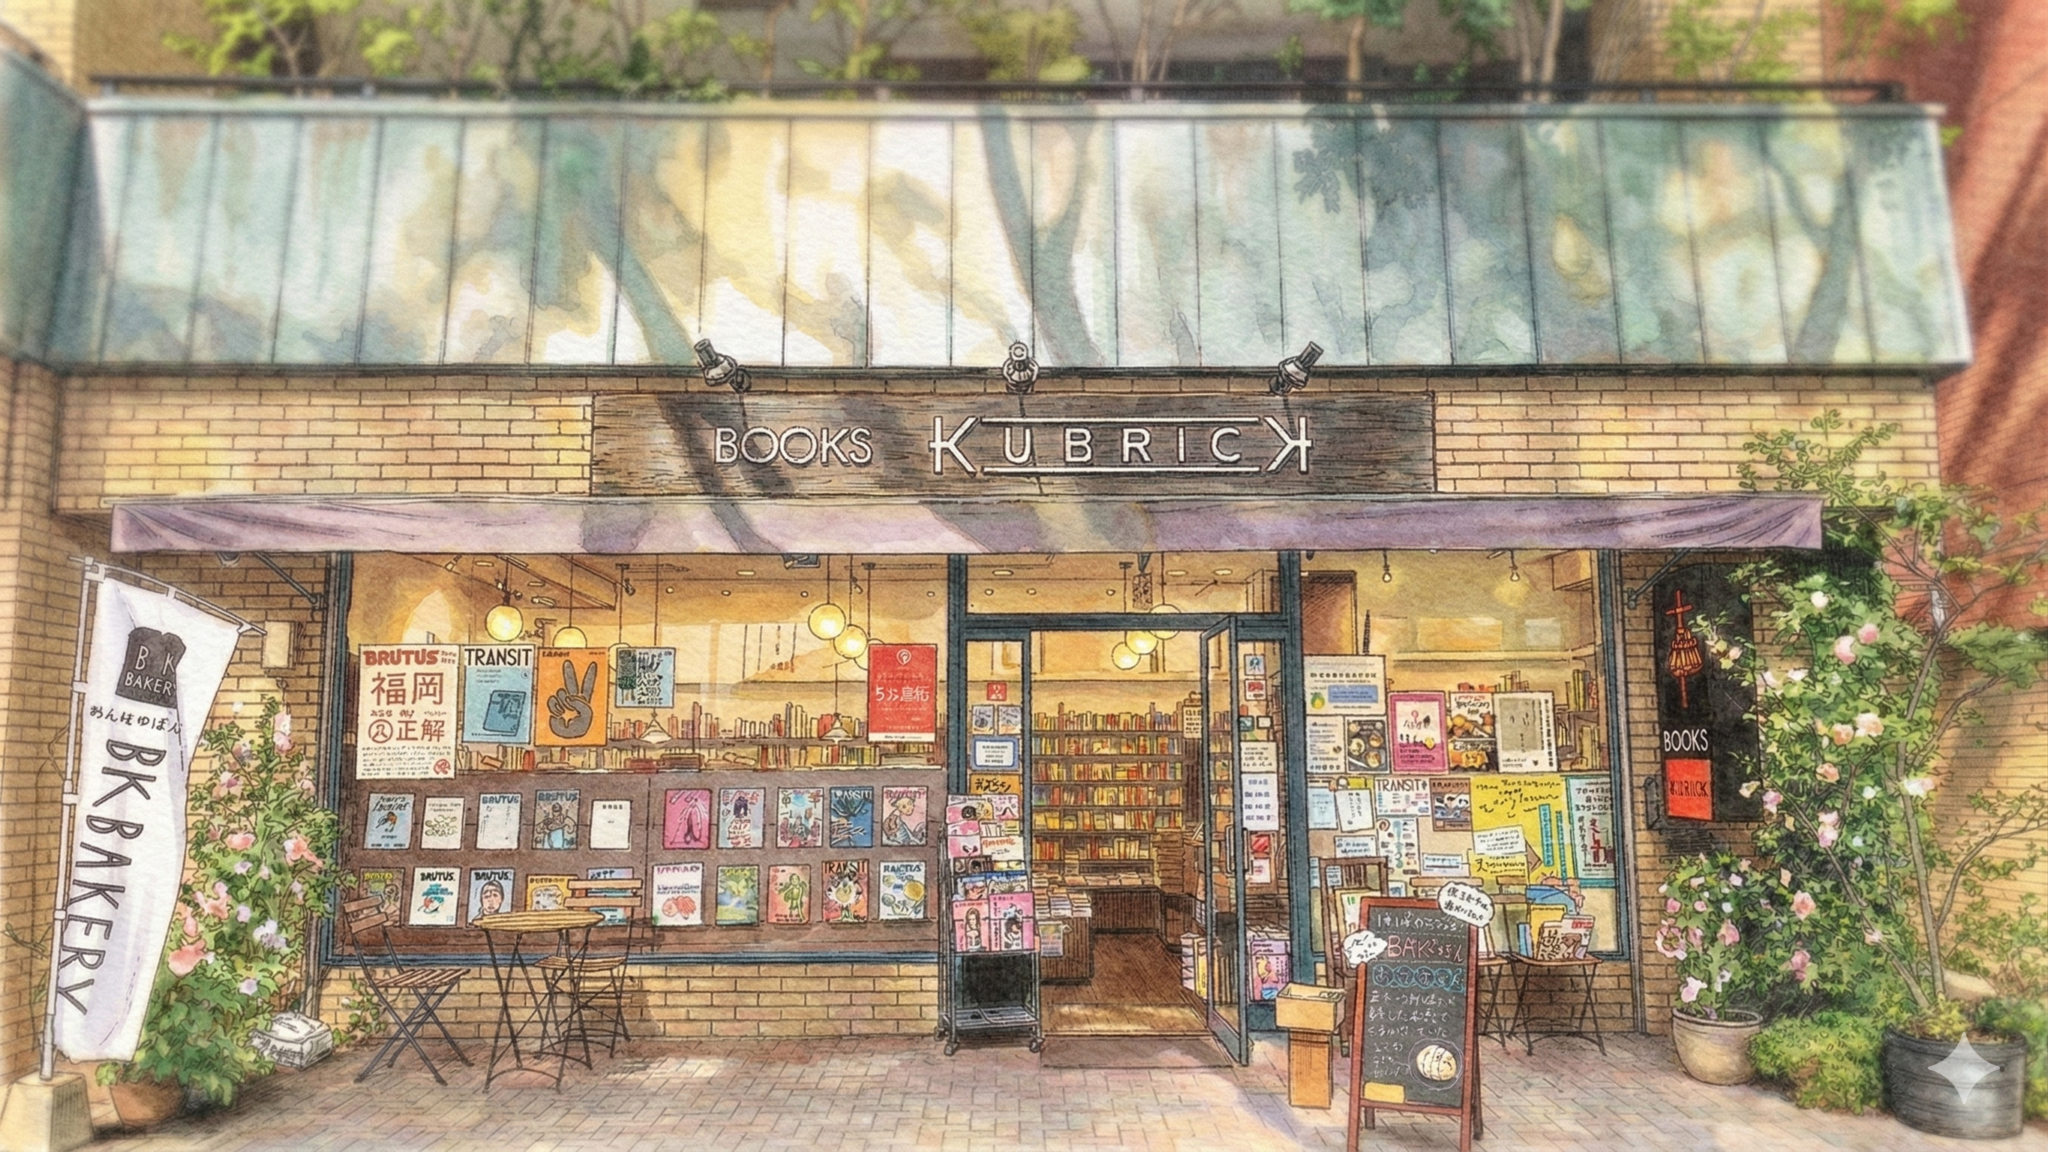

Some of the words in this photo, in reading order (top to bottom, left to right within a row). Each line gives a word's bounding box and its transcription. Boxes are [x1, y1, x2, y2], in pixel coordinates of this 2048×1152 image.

[715, 426, 873, 464] BOOKS
[929, 416, 1313, 476] KUBRICK
[362, 648, 440, 666] BRUTUS
[464, 648, 532, 666] TRANSIT
[124, 671, 176, 696] BAKER
[370, 672, 444, 706] 福岡
[1663, 728, 1709, 752] BOOKS
[92, 739, 167, 807] BK
[1376, 779, 1421, 792] TRANSIT
[57, 814, 144, 1015] BAKERY
